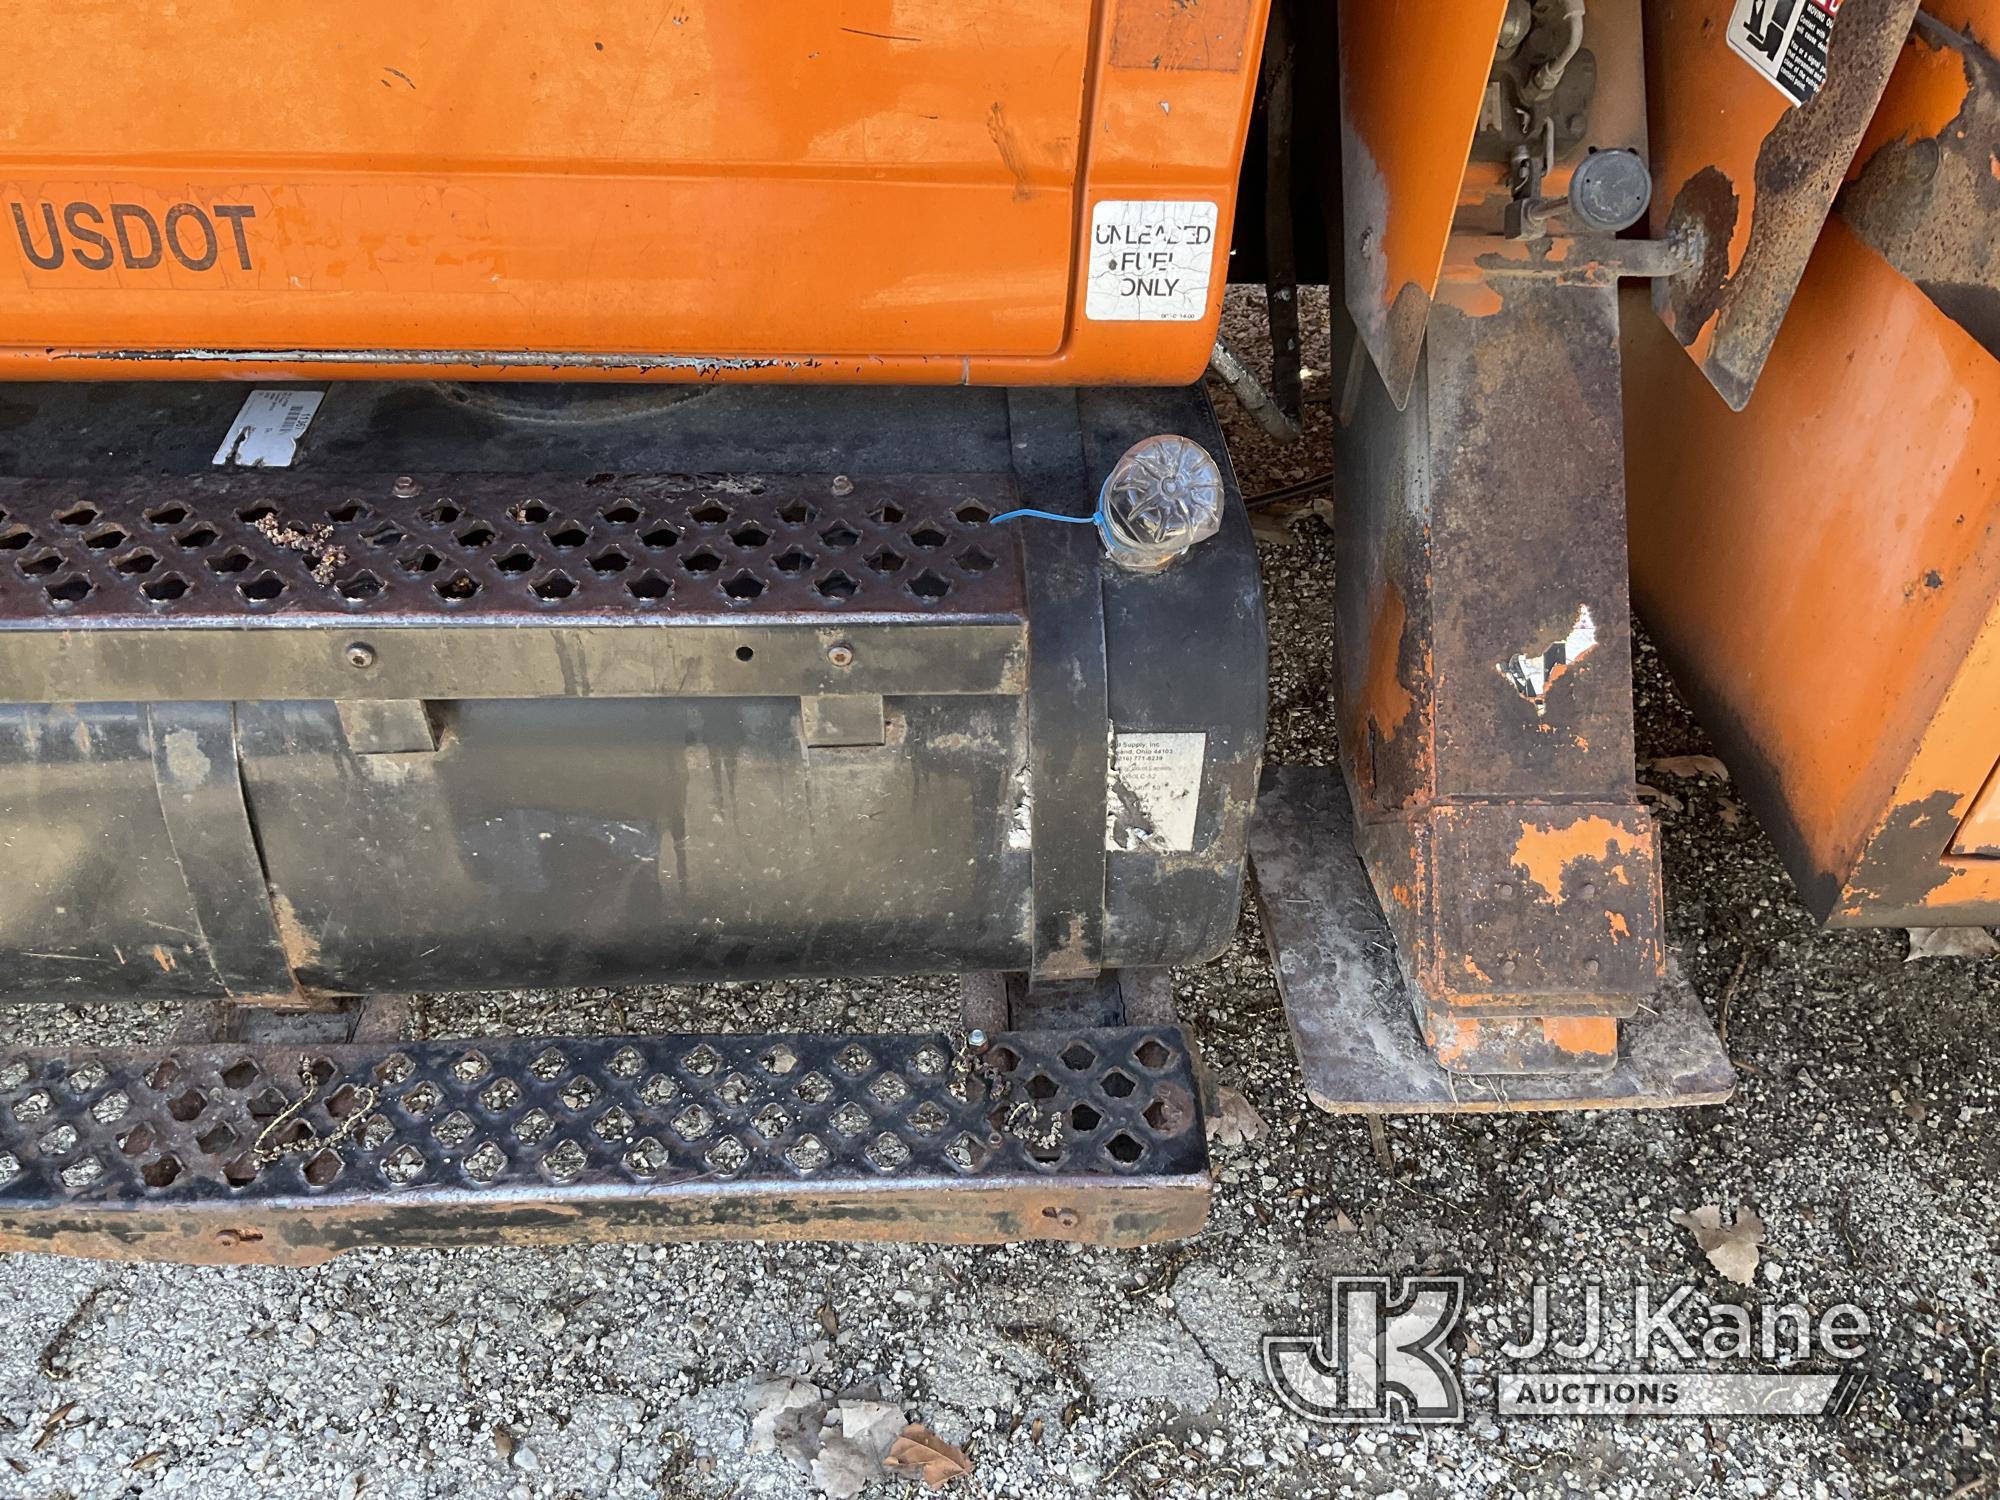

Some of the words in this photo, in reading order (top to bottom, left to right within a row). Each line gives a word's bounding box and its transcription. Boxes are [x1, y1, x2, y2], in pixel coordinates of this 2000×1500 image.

[1806, 3, 1825, 22] MOVING
[1796, 25, 1804, 34] will
[1804, 32, 1817, 45] cause
[1800, 14, 1816, 31] Contact
[1816, 28, 1825, 39] with
[1784, 58, 1794, 70] clear
[1790, 40, 1798, 50] You
[1807, 55, 1821, 68] signal
[1780, 67, 1795, 82] contact
[1786, 48, 1795, 60] that
[1794, 56, 1814, 76] personnel
[1814, 71, 1822, 82] and
[10, 202, 256, 271] USDOT
[1120, 278, 1180, 297] ONLY
